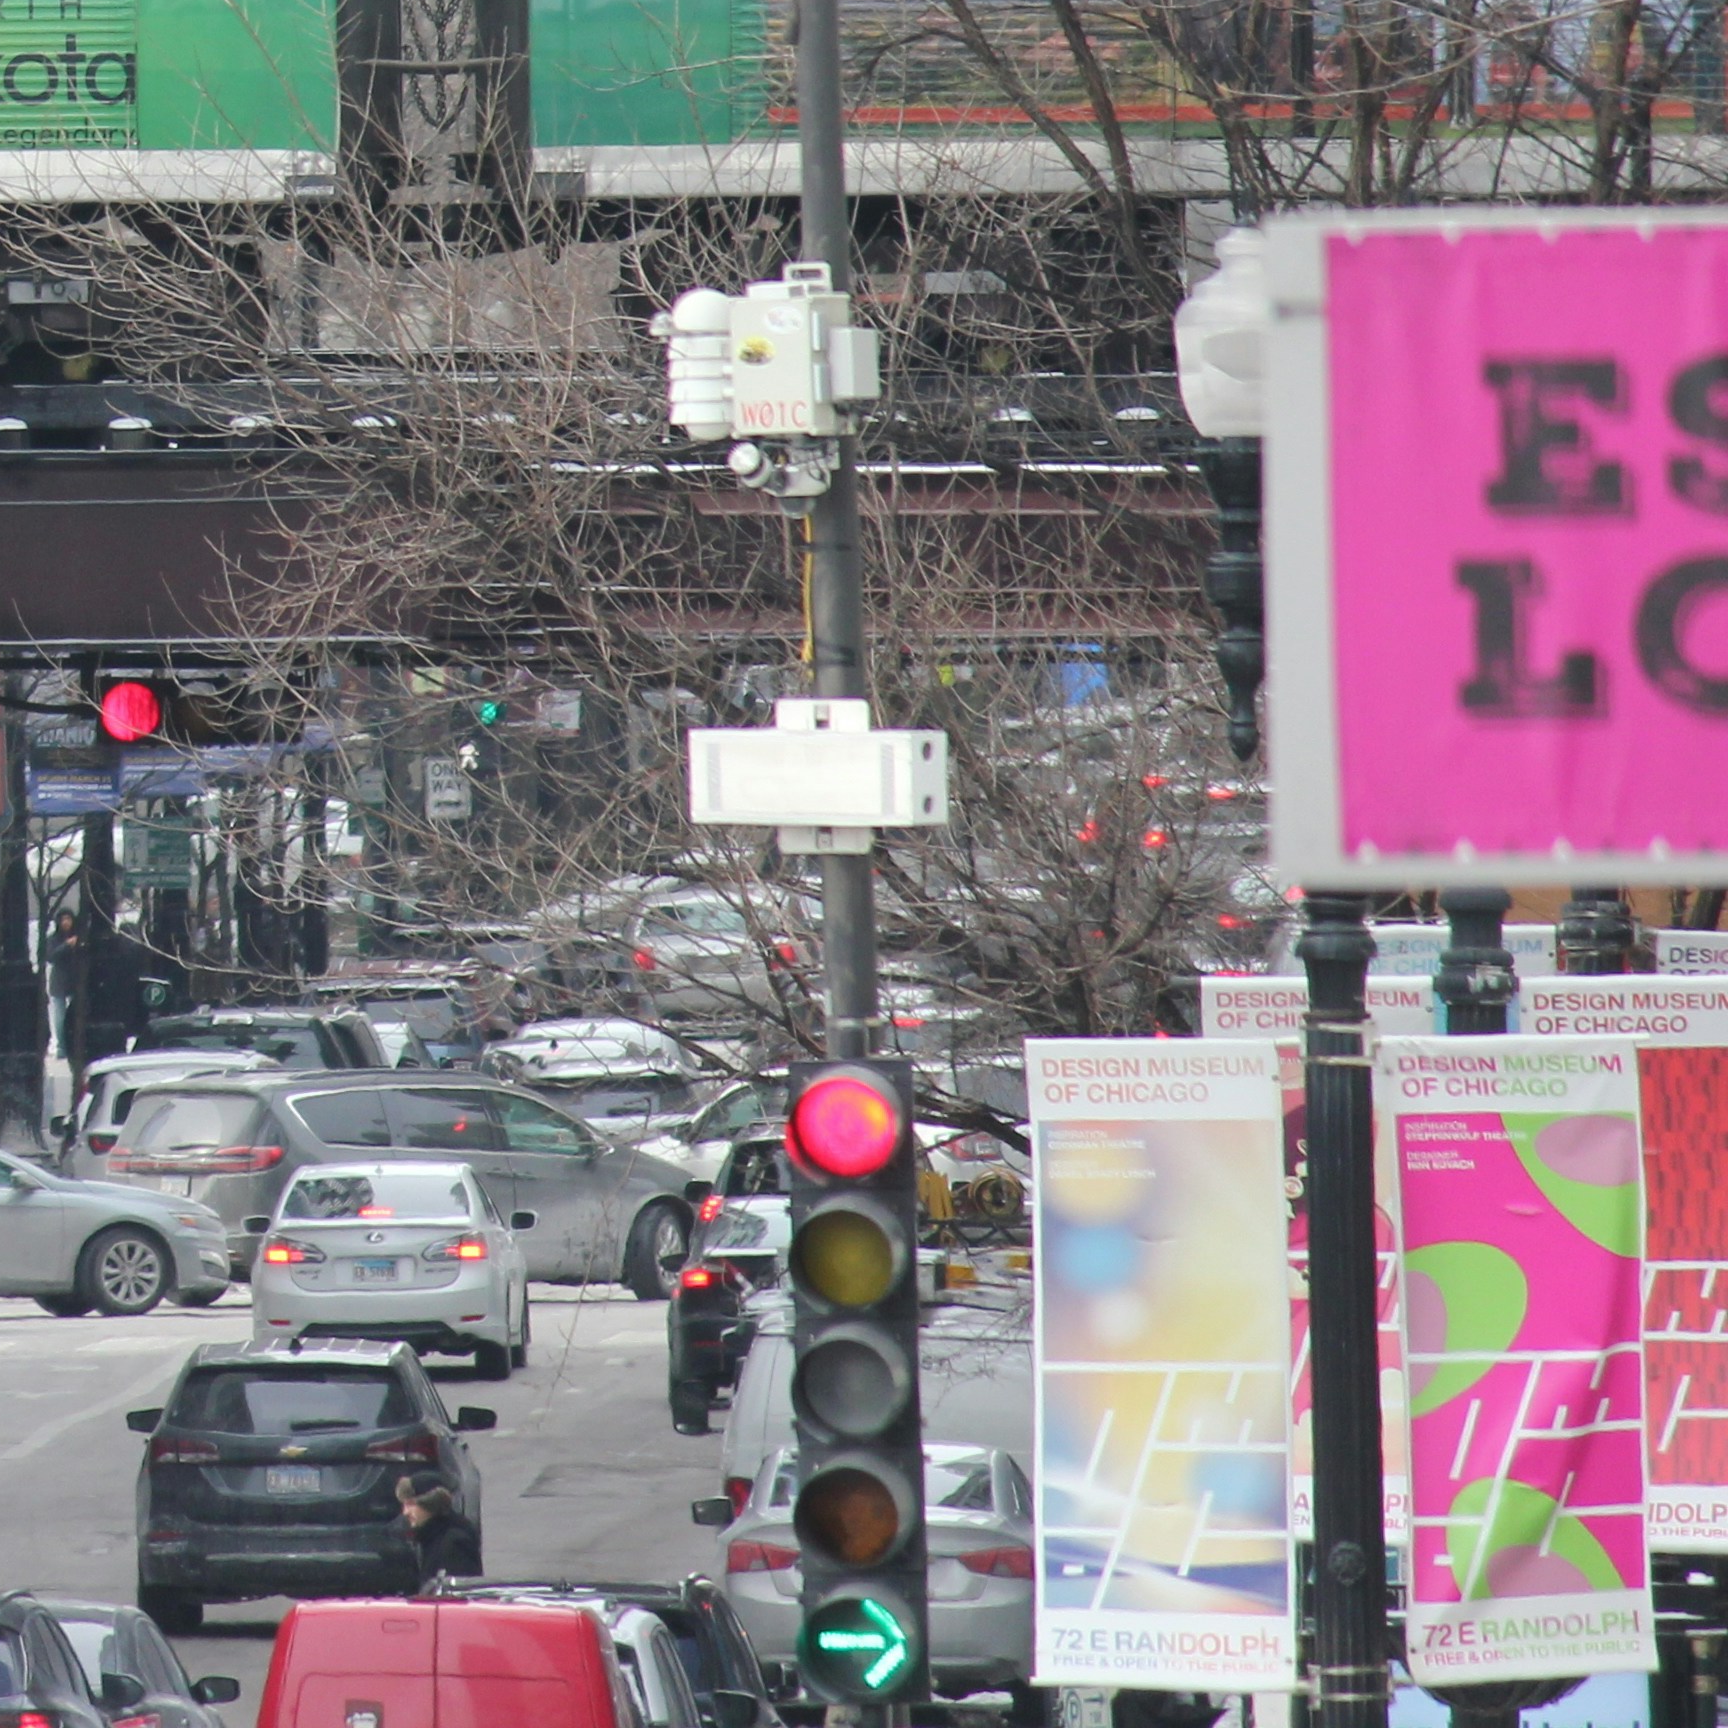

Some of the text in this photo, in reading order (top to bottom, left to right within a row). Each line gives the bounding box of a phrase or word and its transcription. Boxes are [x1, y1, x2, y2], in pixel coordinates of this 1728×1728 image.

[1215, 991, 1307, 1008] DESIGN
[1533, 993, 1624, 1011] DESIGN
[1216, 1013, 1249, 1029] OF
[1535, 1016, 1688, 1034] OF CHICAGO
[1041, 1056, 1265, 1078] DESIGN MUSEUM
[1398, 1053, 1623, 1073] DESIGN MUSEUM
[1044, 1082, 1210, 1104] OF CHICAGO
[1402, 1077, 1568, 1098] OF CHICAGO
[1422, 1610, 1641, 1648] 72 E RANDOLPH
[1051, 1628, 1279, 1657] 72 E RANDOLPH
[1424, 1651, 1464, 1667] FREE
[1483, 1647, 1525, 1663] OPEN
[1529, 1645, 1549, 1658] TO
[1553, 1643, 1580, 1657] THE
[1585, 1639, 1642, 1656] PUBLIC
[1052, 1655, 1094, 1667] FREE
[1114, 1655, 1158, 1669] OPEN
[1163, 1657, 1184, 1669] TO
[1188, 1659, 1219, 1671] THE
[1222, 1661, 1279, 1673] PUBLIC
